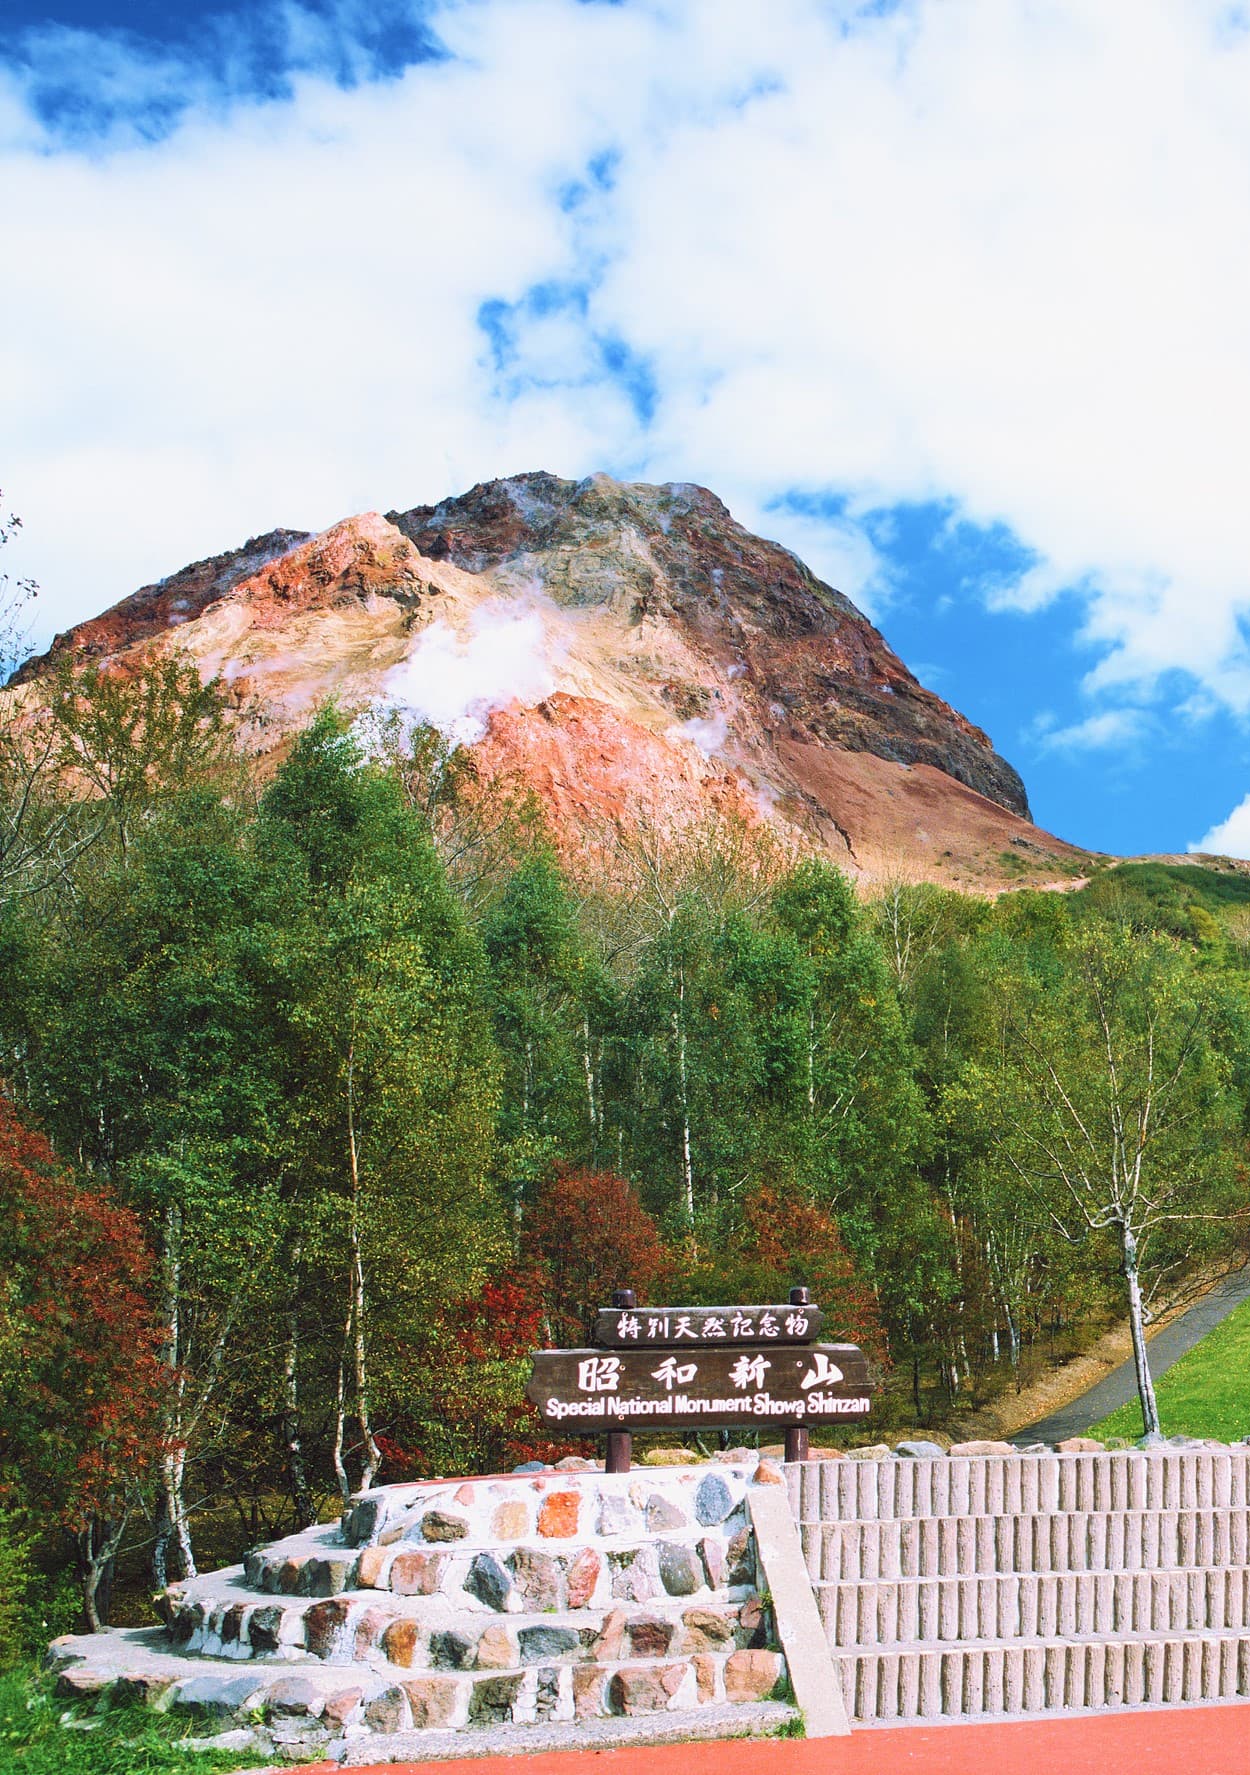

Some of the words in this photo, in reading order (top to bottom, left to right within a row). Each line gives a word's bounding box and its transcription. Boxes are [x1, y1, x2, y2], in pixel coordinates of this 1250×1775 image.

[617, 1311, 809, 1339] 特別天然記念物
[577, 1353, 844, 1393] 昭和新山
[546, 1397, 605, 1420] Special
[607, 1395, 673, 1415] National
[675, 1395, 752, 1414] Monument
[753, 1392, 806, 1415] Showa
[807, 1391, 870, 1414] Shinzan
